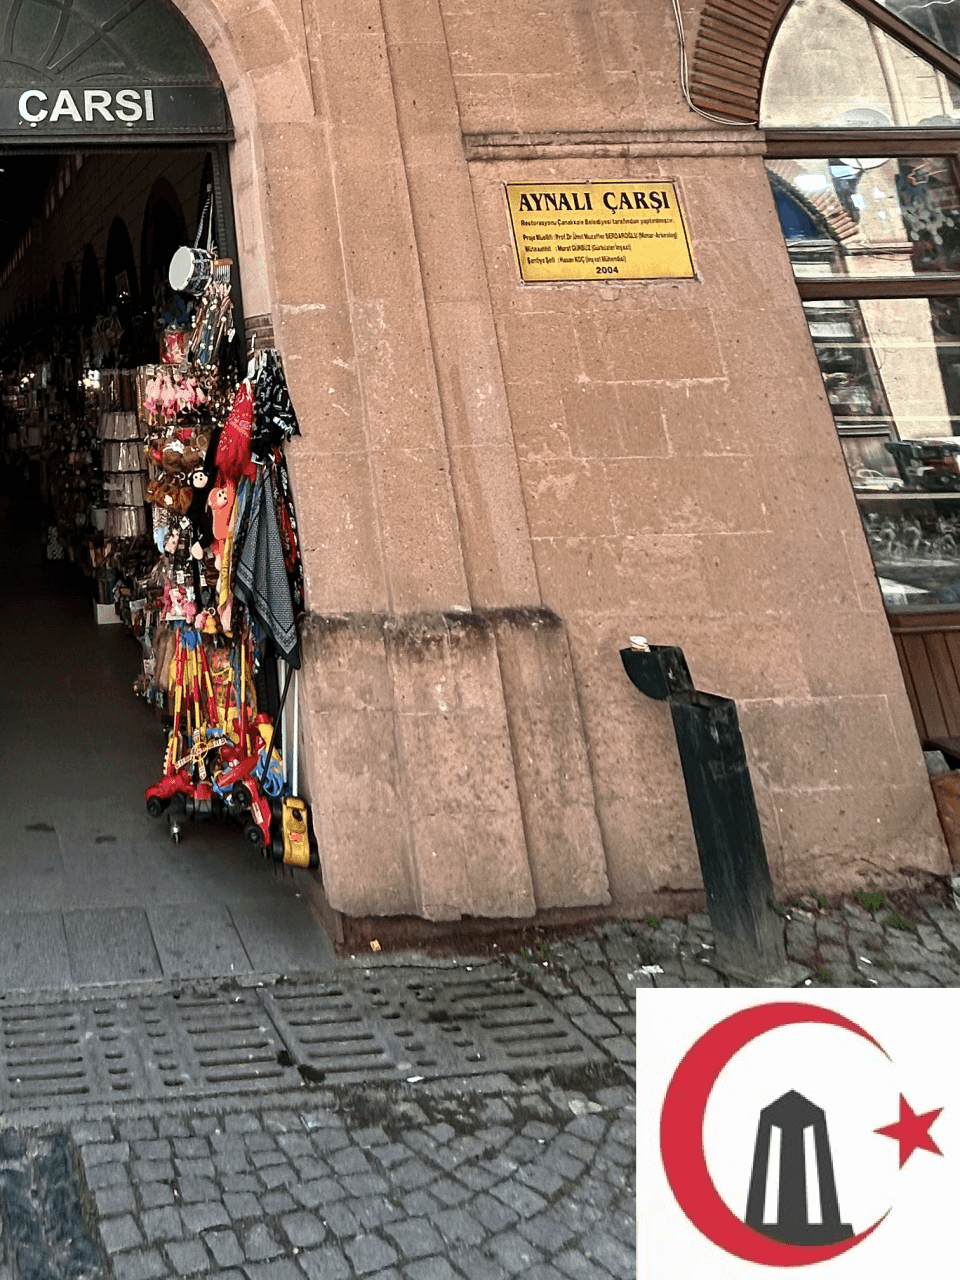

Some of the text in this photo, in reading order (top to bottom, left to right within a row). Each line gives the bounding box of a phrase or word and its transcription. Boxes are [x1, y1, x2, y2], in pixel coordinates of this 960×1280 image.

[519, 191, 671, 214] AYNALI ÇARŞI
[596, 266, 618, 274] 2004
